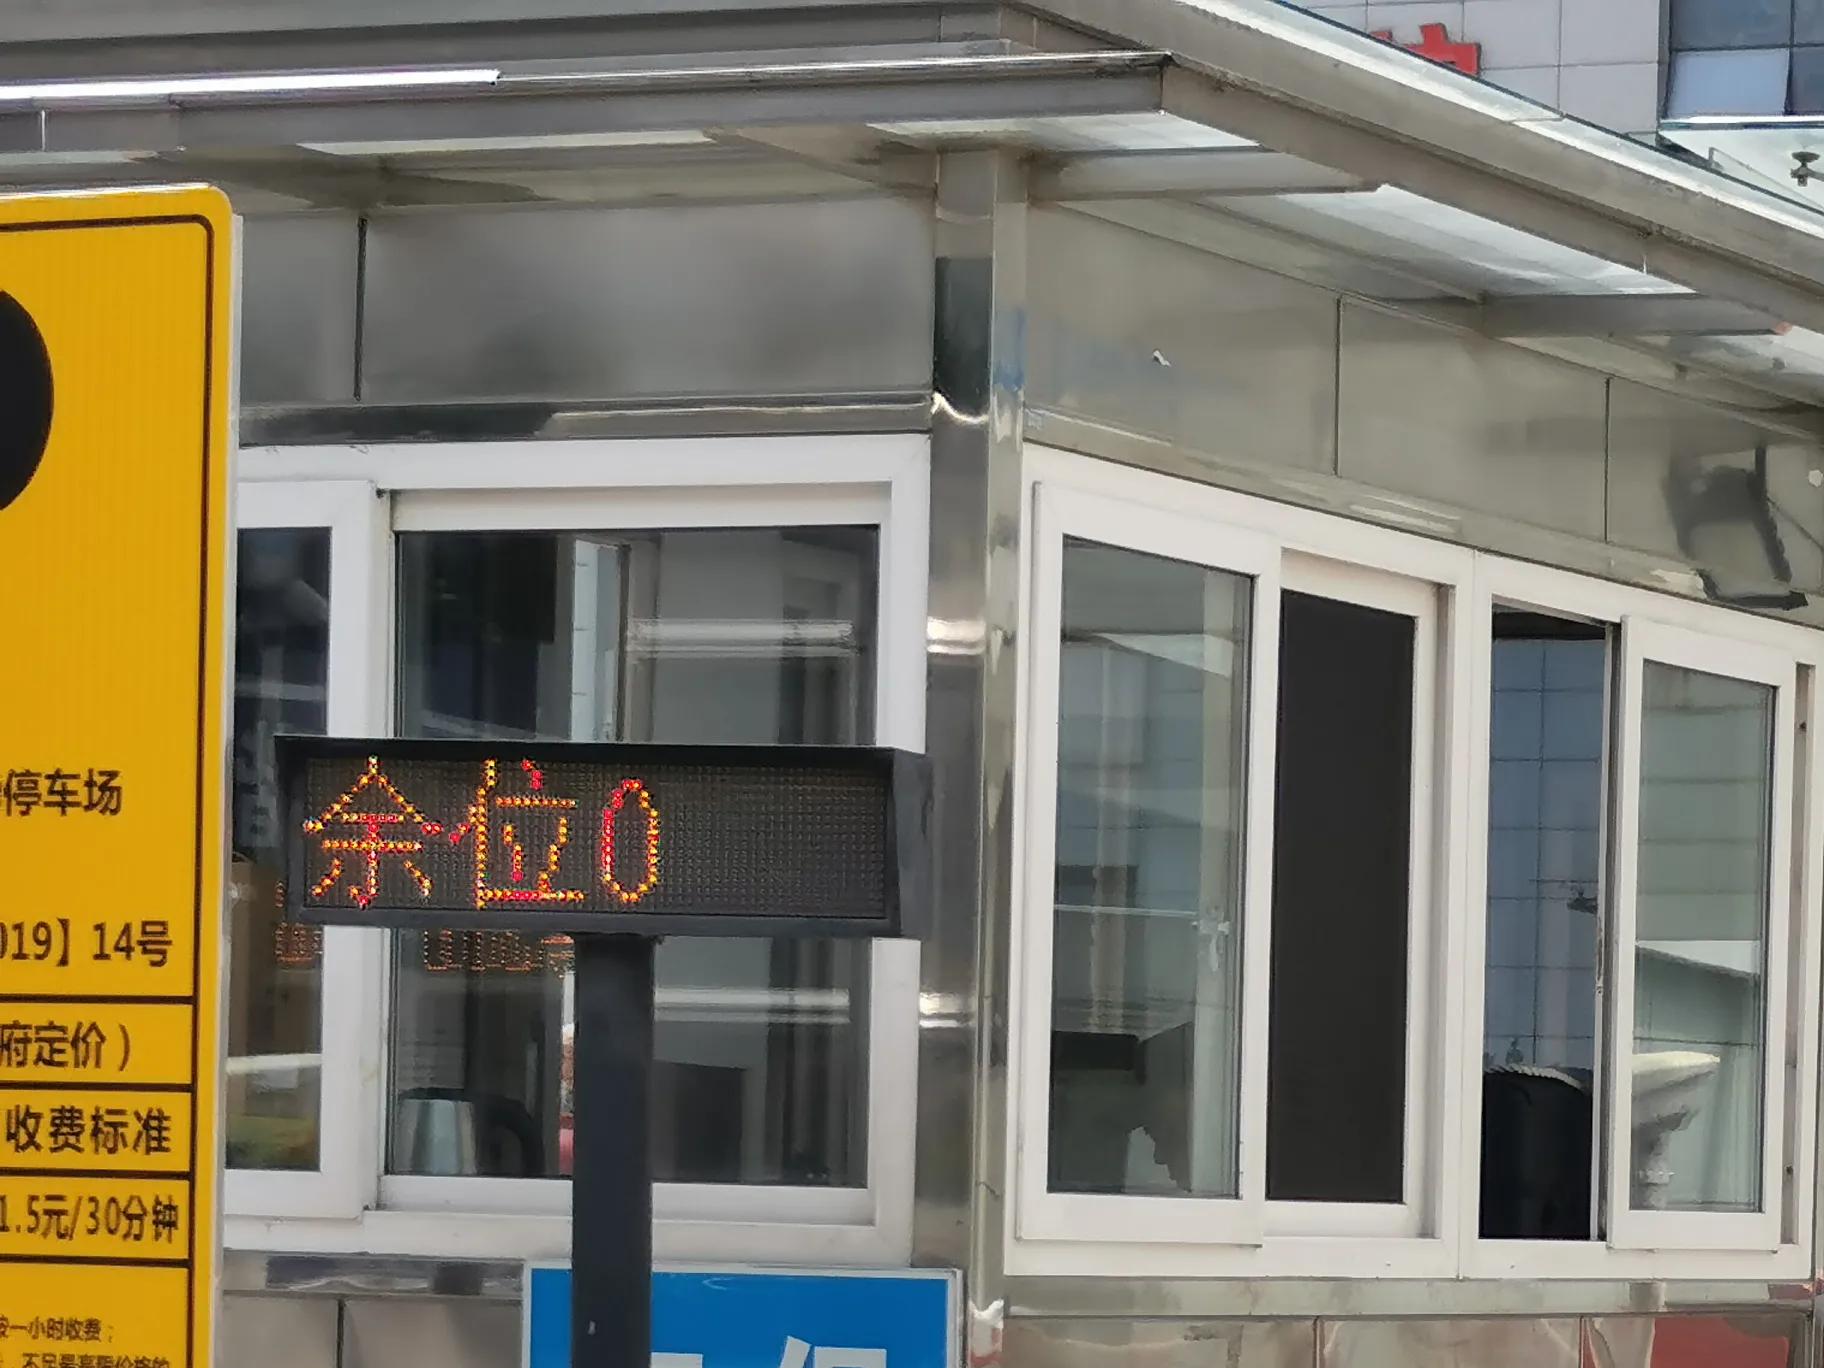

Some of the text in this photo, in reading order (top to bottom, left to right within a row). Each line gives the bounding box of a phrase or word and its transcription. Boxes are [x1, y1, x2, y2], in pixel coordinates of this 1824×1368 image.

[3, 767, 123, 816] 停车场
[303, 755, 662, 909] 余位0
[6, 1104, 173, 1155] 收费标准
